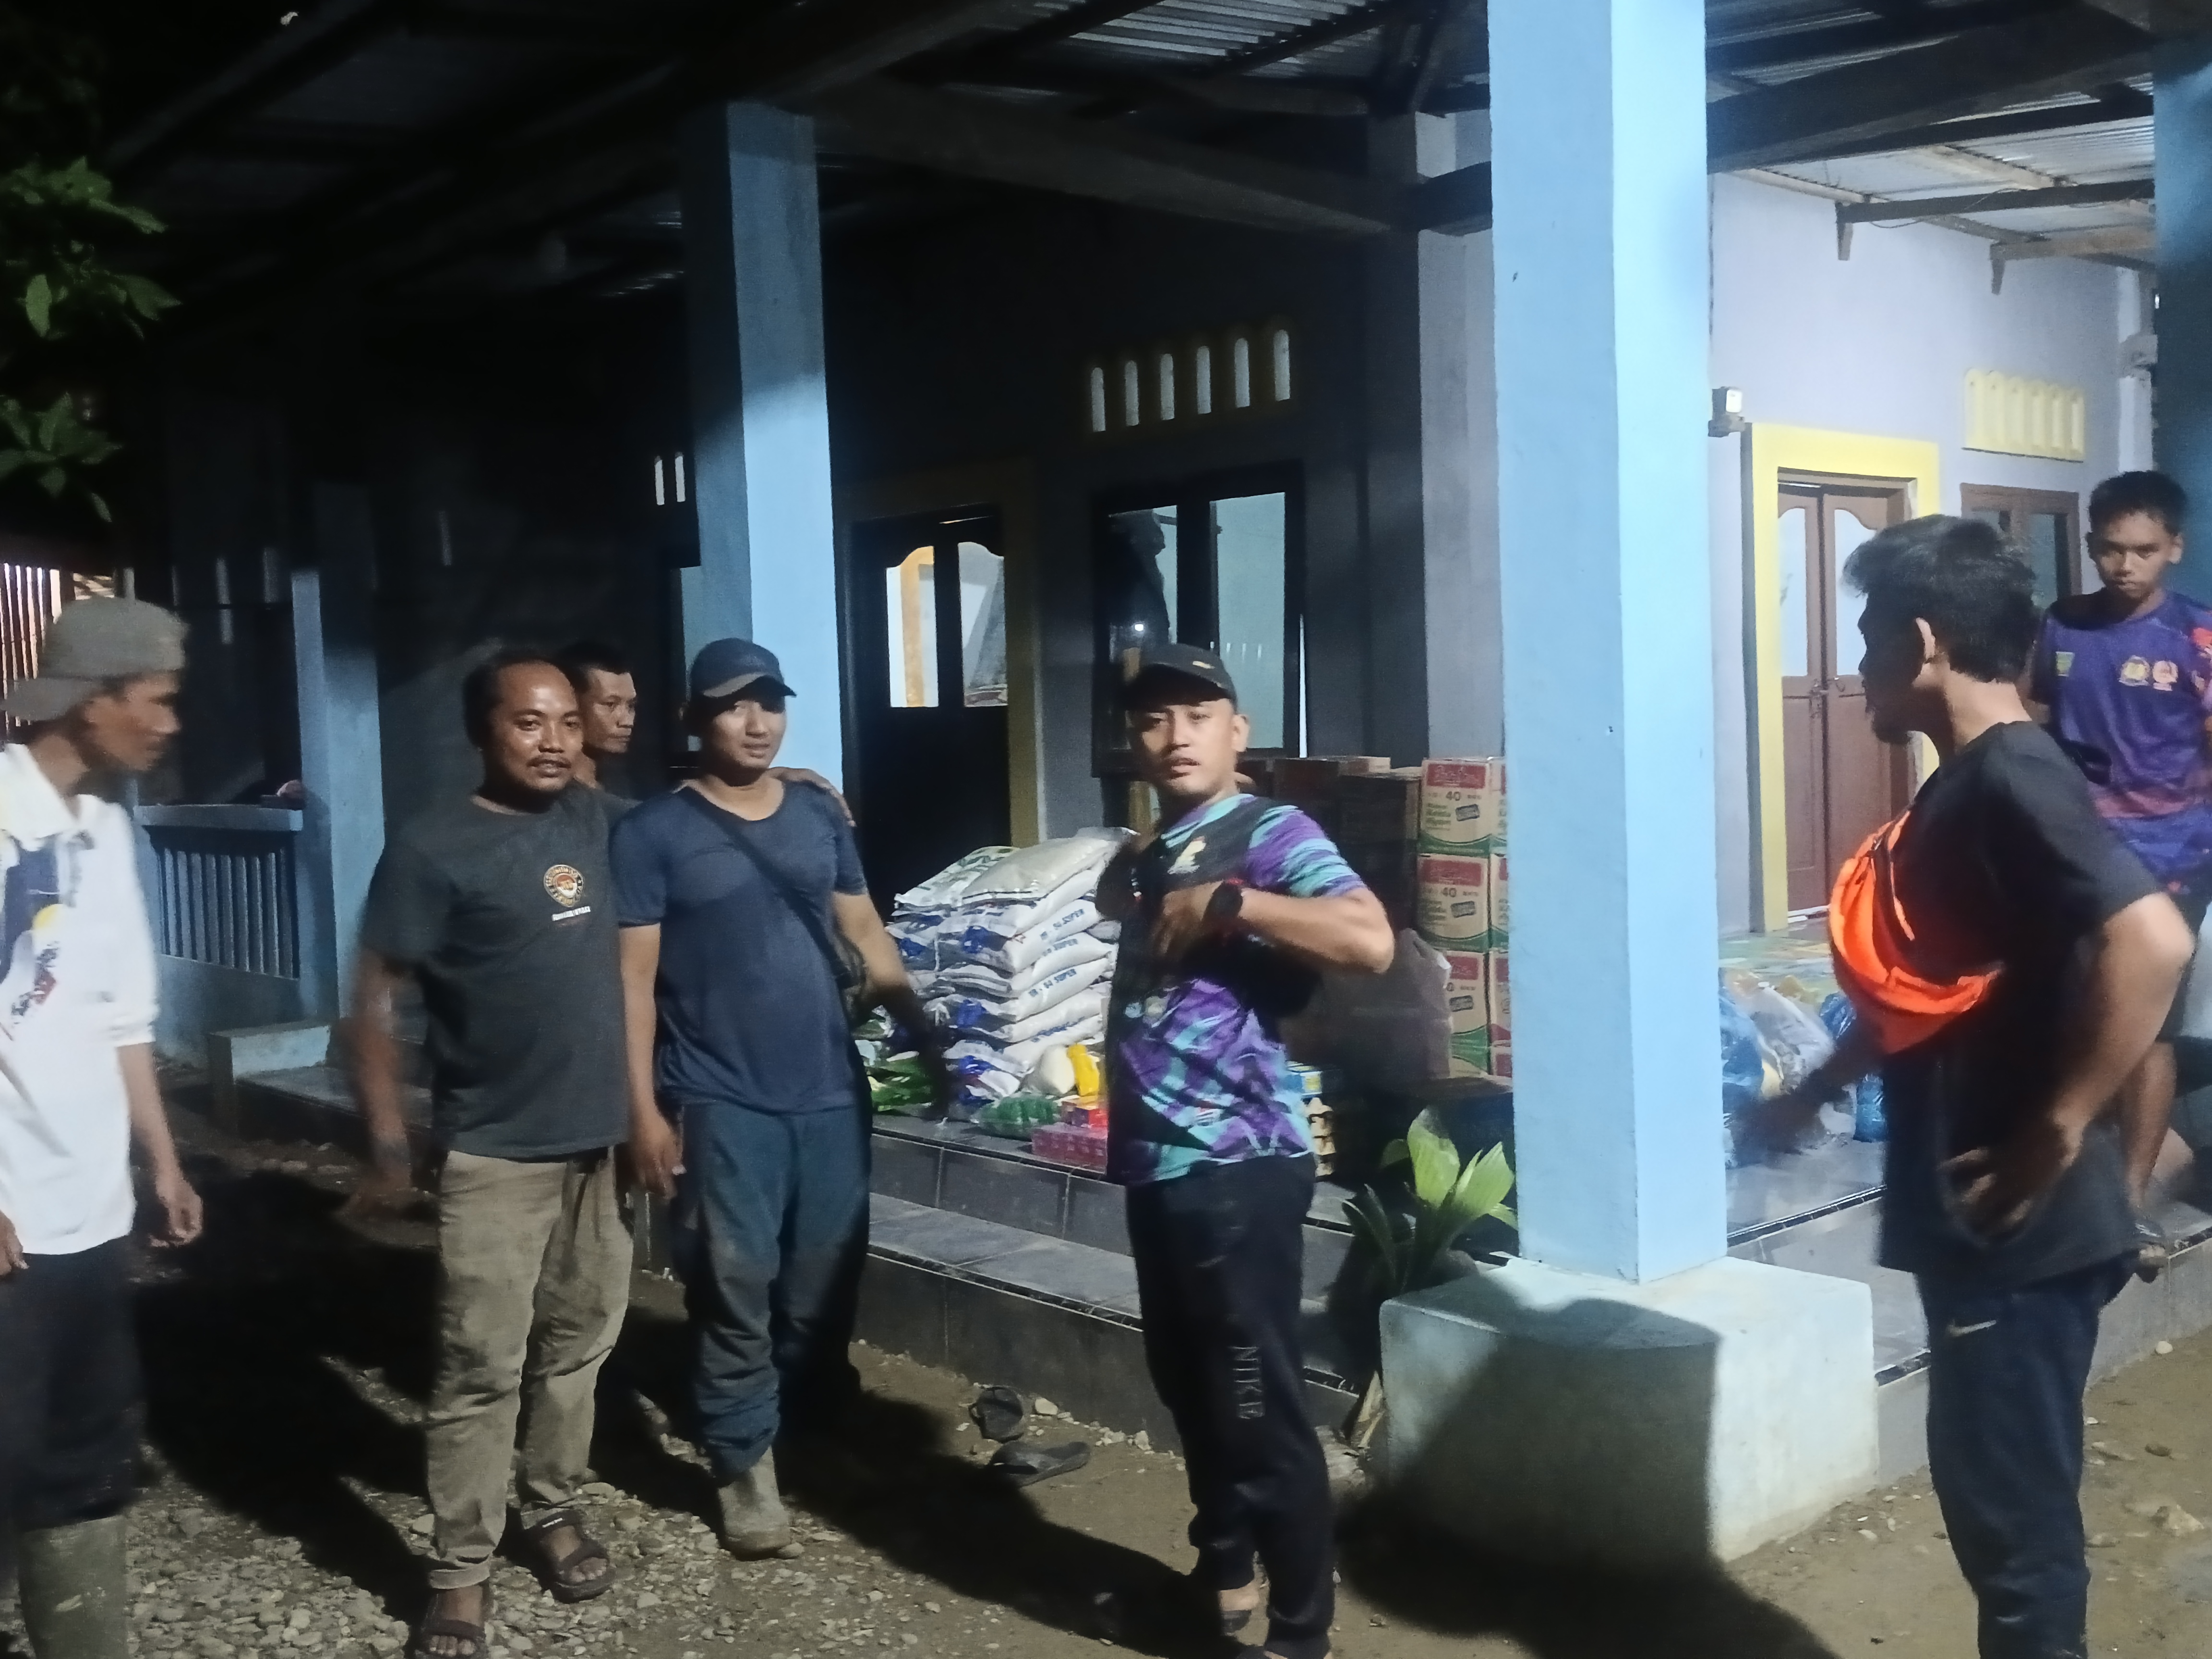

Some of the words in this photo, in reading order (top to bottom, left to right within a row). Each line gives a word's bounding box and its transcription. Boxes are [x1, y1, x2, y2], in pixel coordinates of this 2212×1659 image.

[1446, 791, 1461, 801] 40
[1442, 887, 1457, 898] 40
[1054, 969, 1077, 983] SUPER
[1230, 1346, 1265, 1419] NIKE
